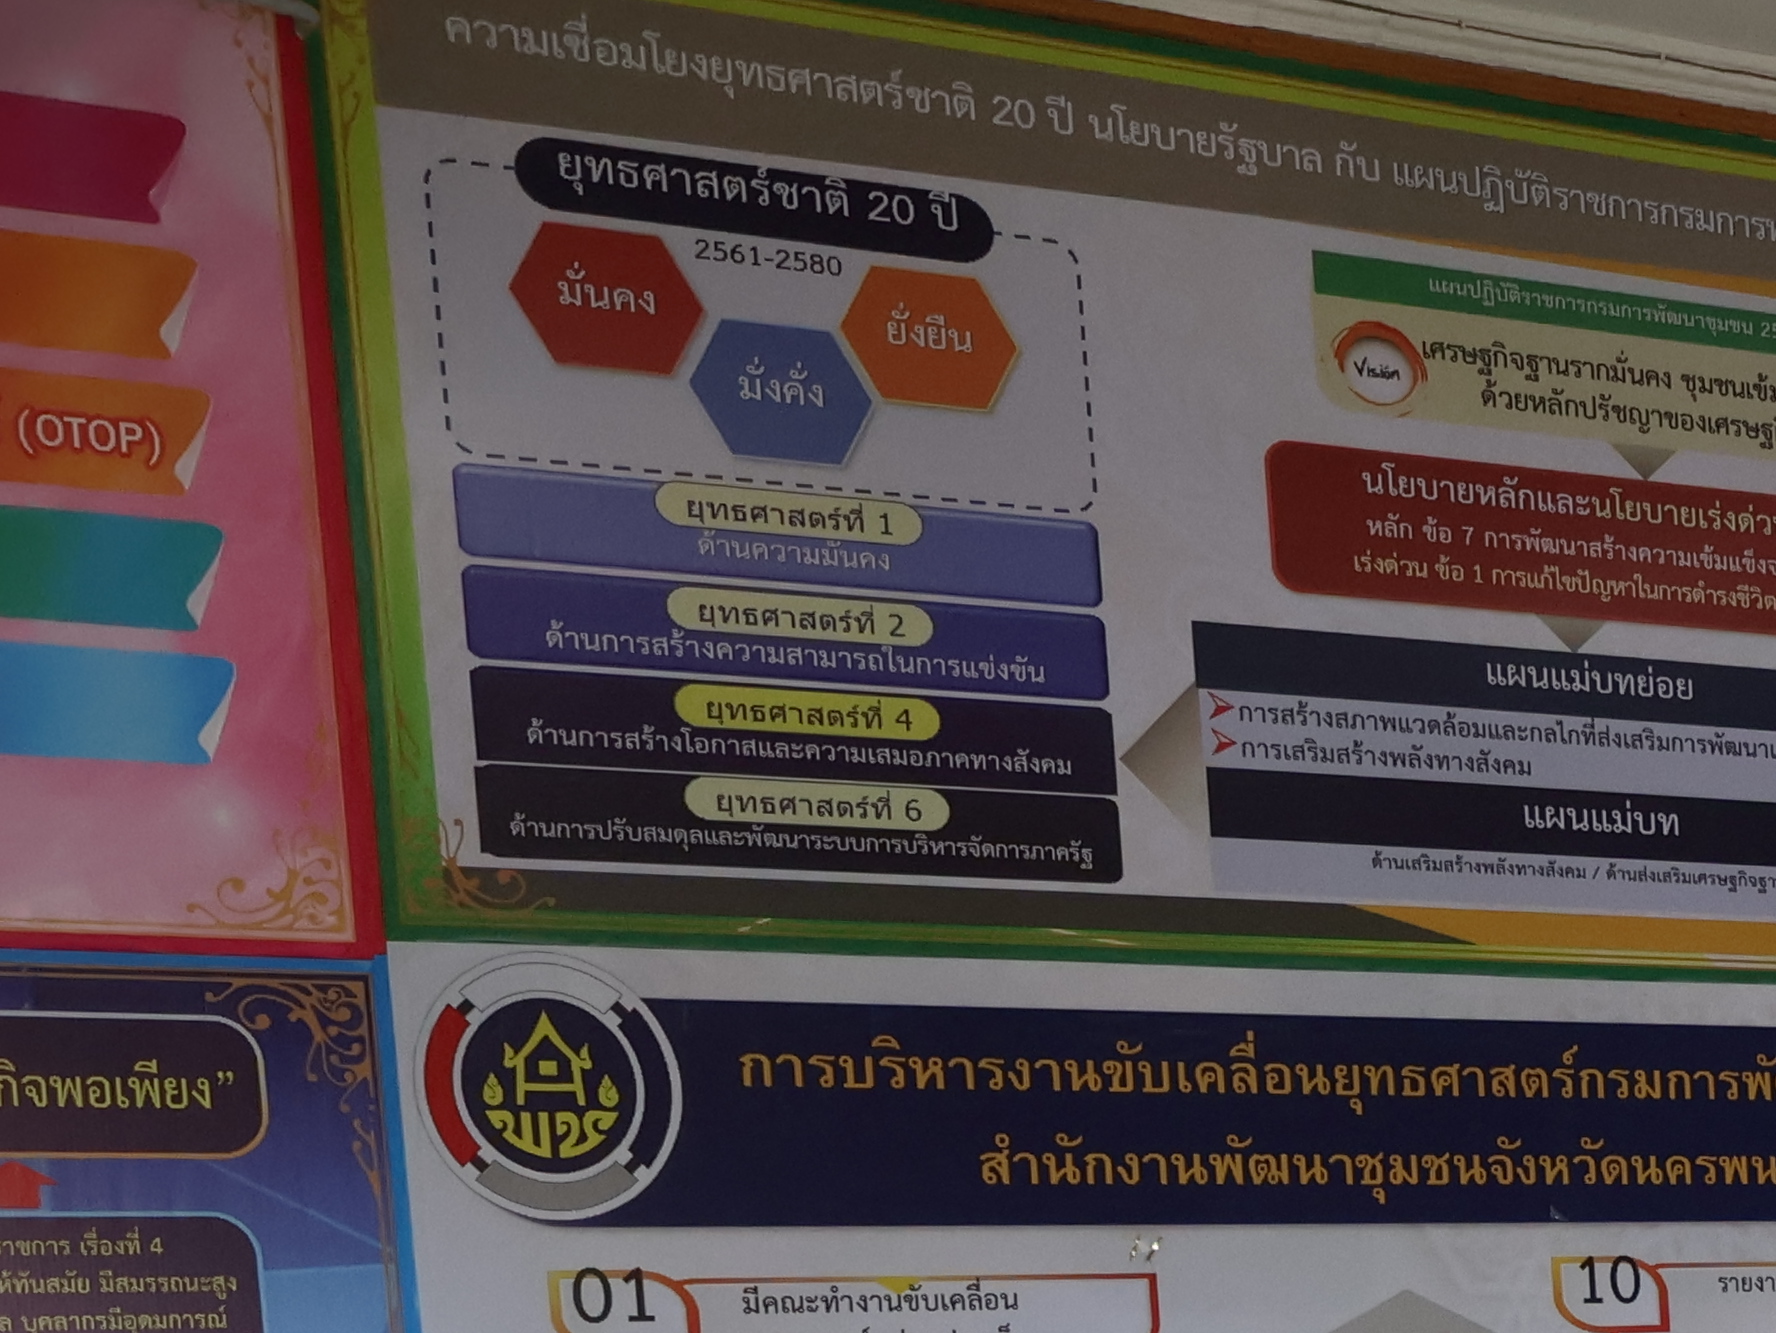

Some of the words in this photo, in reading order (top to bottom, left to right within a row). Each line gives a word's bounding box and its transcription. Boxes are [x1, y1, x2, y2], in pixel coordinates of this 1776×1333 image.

[445, 13, 976, 122] ความเชื่อมโยงยุทธศาสตร์ชาติ
[993, 95, 1035, 129] 20
[1047, 97, 1072, 137] ปี
[1088, 103, 1323, 181] นโยบายรัฐบาล
[1335, 137, 1381, 184] กับ
[557, 149, 850, 219] ยุทธศาสตร์ชาติ
[868, 191, 914, 226] 20
[928, 190, 960, 233] ปี
[693, 238, 843, 278] 2561-2580
[557, 262, 656, 316] มั่นคง
[887, 302, 973, 354] ยั่งยืน
[738, 358, 825, 410] มั่งคั่ง
[1421, 337, 1673, 393] เศรษฐกิจฐานรากมั่นคง
[18, 408, 162, 466] (OTOP)
[686, 491, 865, 538] ยุทธศาสตร์ที่
[879, 513, 894, 537] 1
[1367, 516, 1413, 540] หลัก
[1423, 520, 1453, 545] ข้อ
[1462, 525, 1473, 545] 7
[1436, 556, 1464, 581] ข้อ
[697, 593, 877, 639] ยุทธศาสตร์ที่
[887, 614, 906, 638] 2
[545, 620, 1045, 684] ด้านการสร้างความสามารถในการแข่งขัน
[1485, 656, 1695, 702] แผนแม่บทย่อย
[705, 690, 884, 735] ยุทธศาสตร์ที่
[894, 709, 912, 733] 4
[1240, 734, 1534, 779] การเสริมสร้างพลังทางสังคม
[716, 784, 894, 827] ยุทธศาสตร์ที่
[904, 798, 922, 823] 6
[1522, 797, 1682, 839] แผนแม่บท
[150, 1237, 164, 1256] 4
[572, 1267, 656, 1325] 01
[741, 1275, 1019, 1318] มีคณะทำงานขับเคลื่อน
[1578, 1254, 1642, 1306] 10
